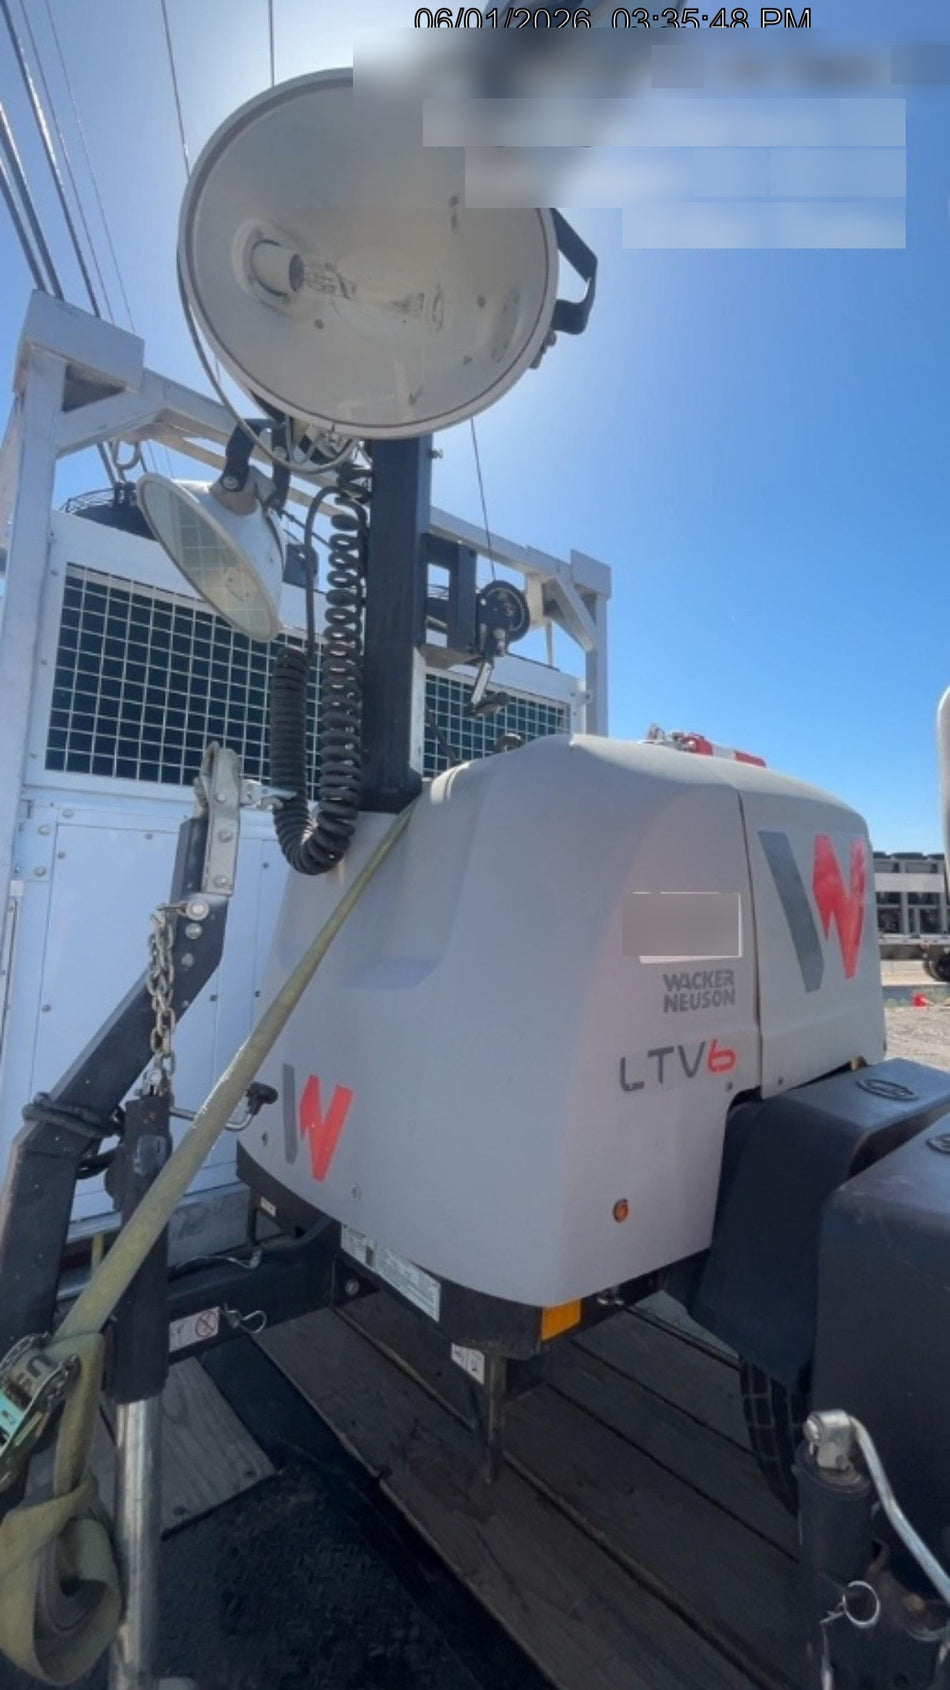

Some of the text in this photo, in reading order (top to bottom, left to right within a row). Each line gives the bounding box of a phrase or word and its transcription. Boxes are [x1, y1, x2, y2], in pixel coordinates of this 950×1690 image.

[662, 969, 735, 992] WACKER
[663, 988, 736, 1013] NEUSON
[620, 1038, 736, 1092] LTV6
